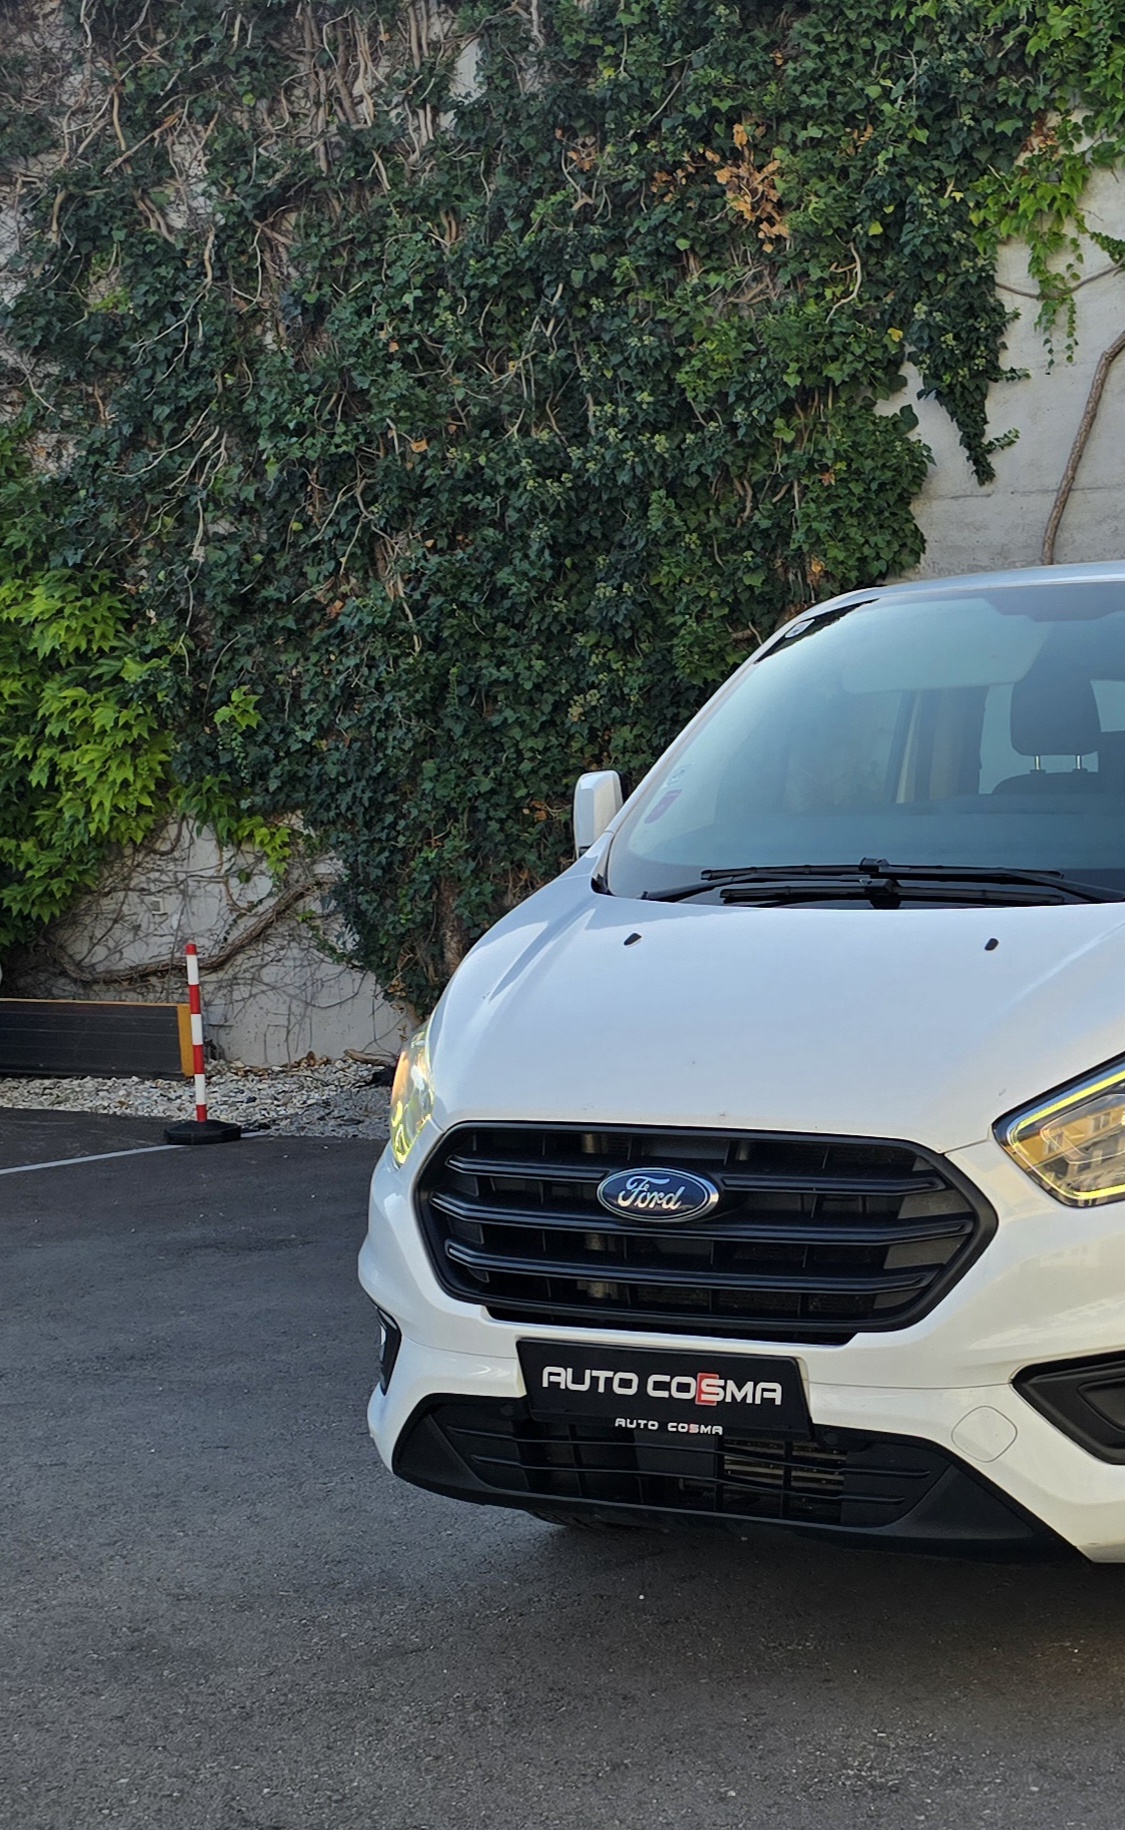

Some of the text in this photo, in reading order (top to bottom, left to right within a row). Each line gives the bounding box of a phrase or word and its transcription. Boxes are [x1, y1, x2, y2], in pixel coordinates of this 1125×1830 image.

[618, 1175, 685, 1210] Ford
[541, 1365, 783, 1406] AUTO COSMA
[614, 1418, 723, 1436] AUTO COSMA
